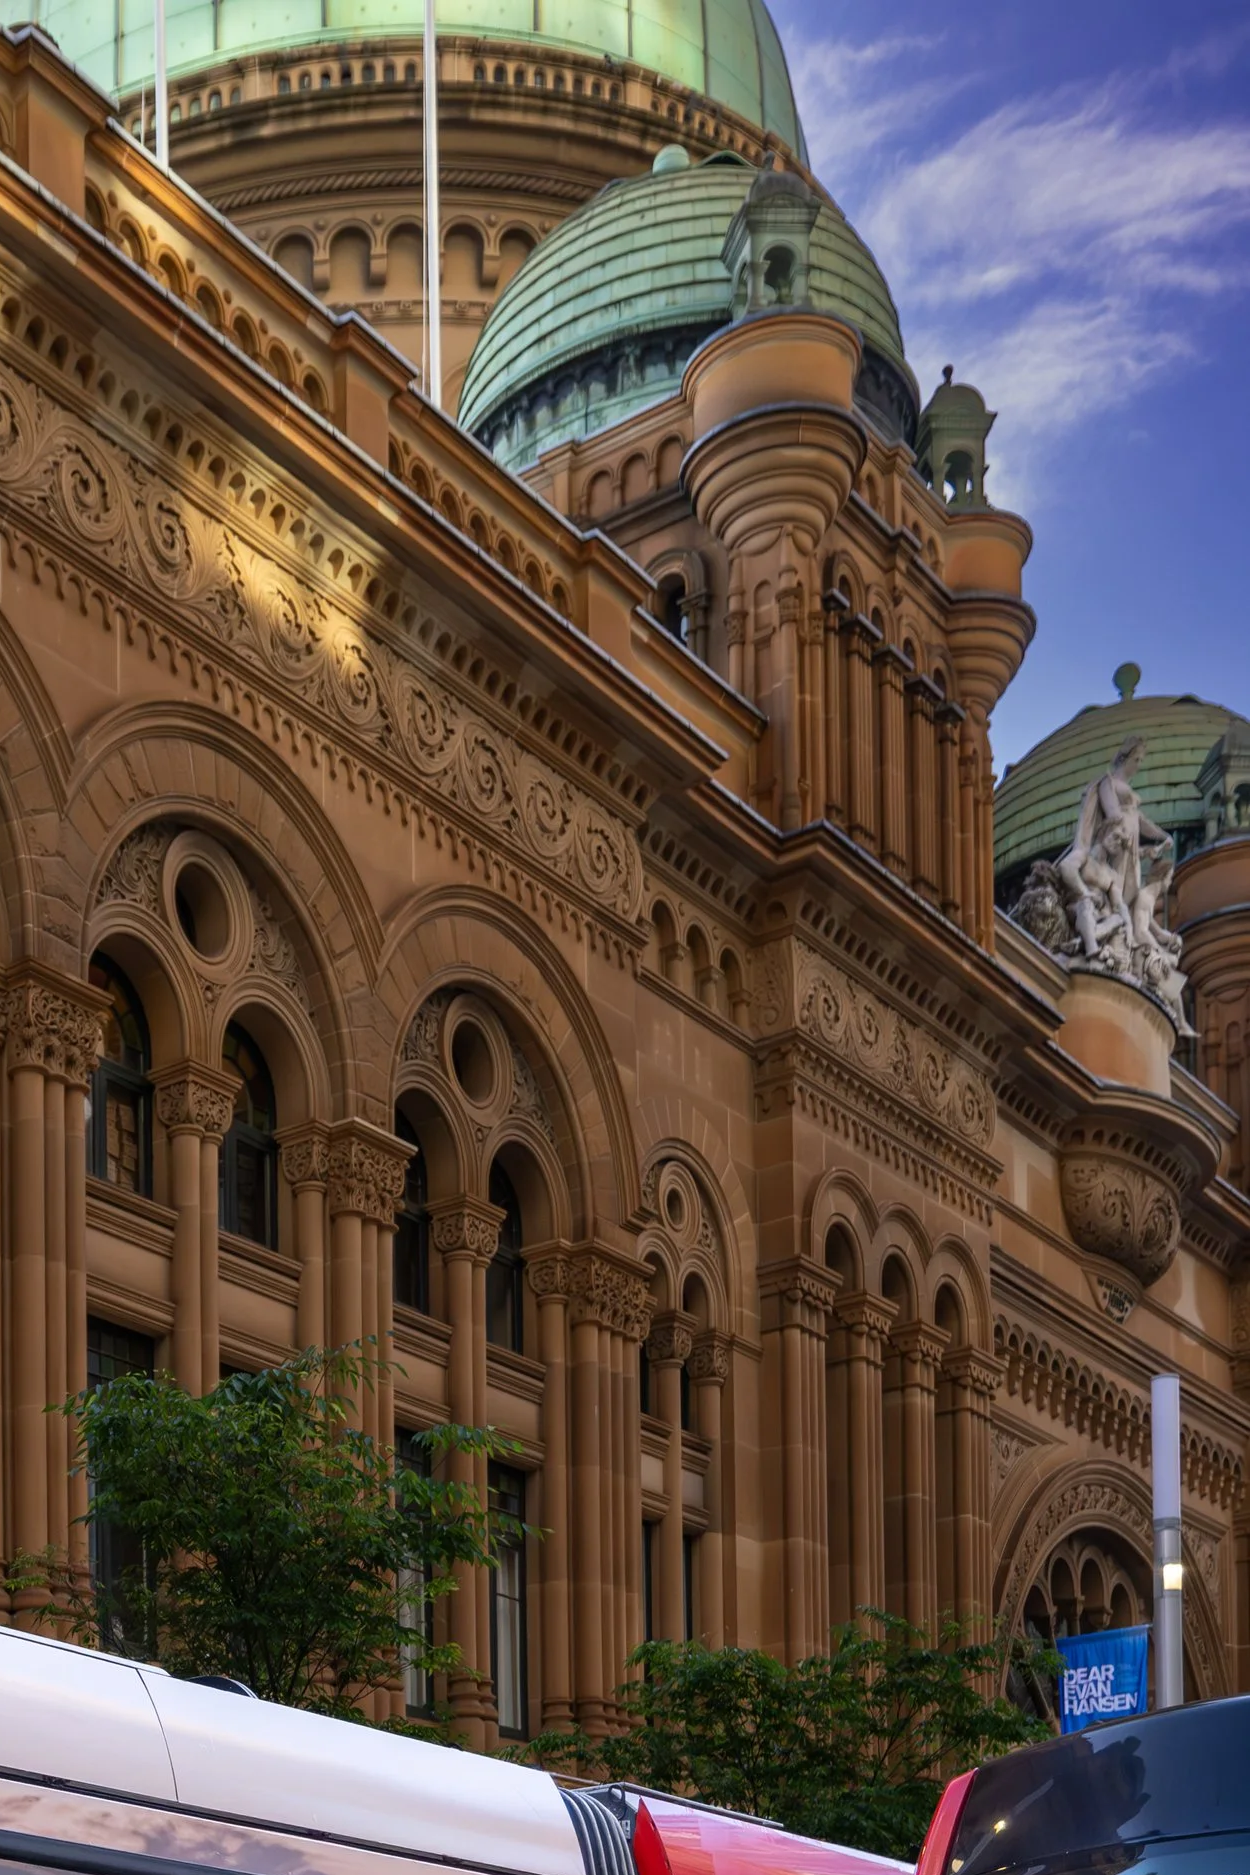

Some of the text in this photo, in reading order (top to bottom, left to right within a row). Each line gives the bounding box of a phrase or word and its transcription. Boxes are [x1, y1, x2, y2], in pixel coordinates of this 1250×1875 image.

[1063, 1664, 1114, 1685] DEAR
[1063, 1680, 1111, 1700] EVAN
[1063, 1692, 1138, 1716] HANSEN
